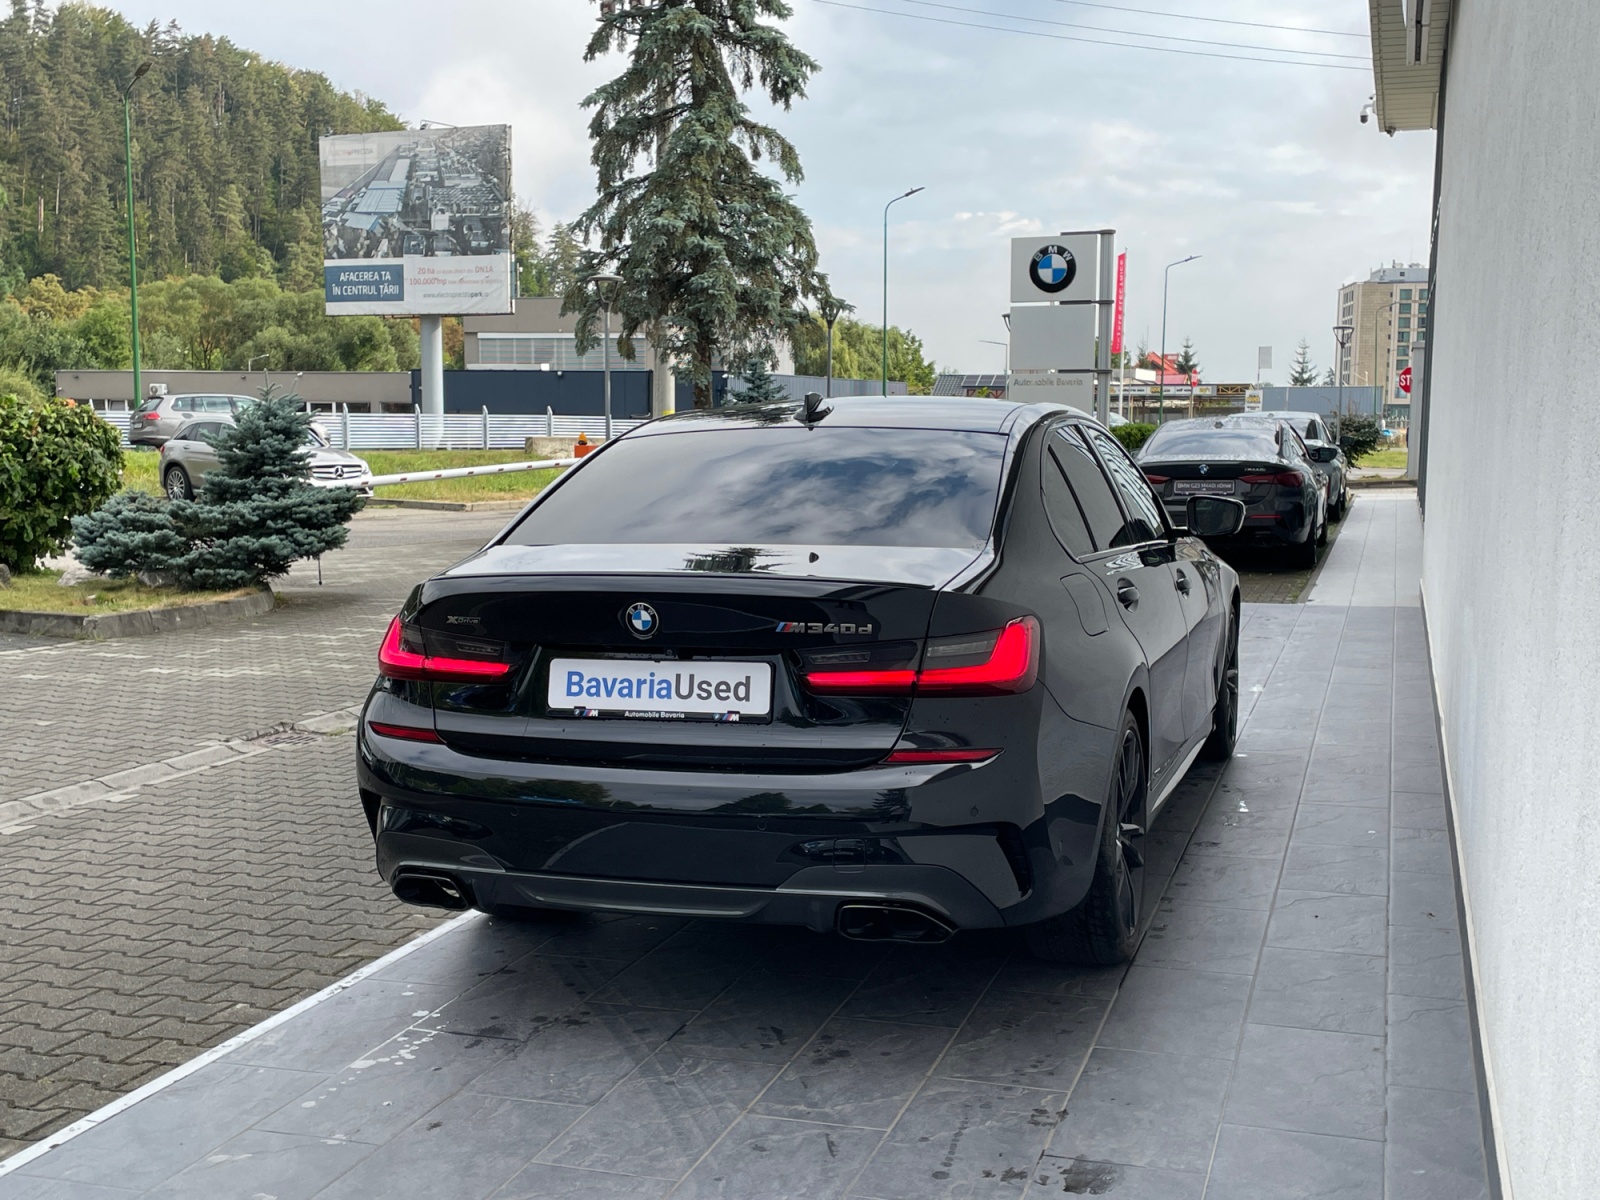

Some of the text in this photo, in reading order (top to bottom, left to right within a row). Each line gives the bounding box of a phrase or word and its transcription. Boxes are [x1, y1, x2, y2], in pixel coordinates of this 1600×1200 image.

[1034, 245, 1073, 262] BMW
[340, 271, 392, 282] AFACEREA TA
[332, 283, 341, 296] ÎN
[342, 285, 378, 296] CENTRUL
[787, 622, 872, 634] M340d
[565, 670, 752, 702] BavariaUsed
[624, 710, 685, 719] Automobile Bavaria
